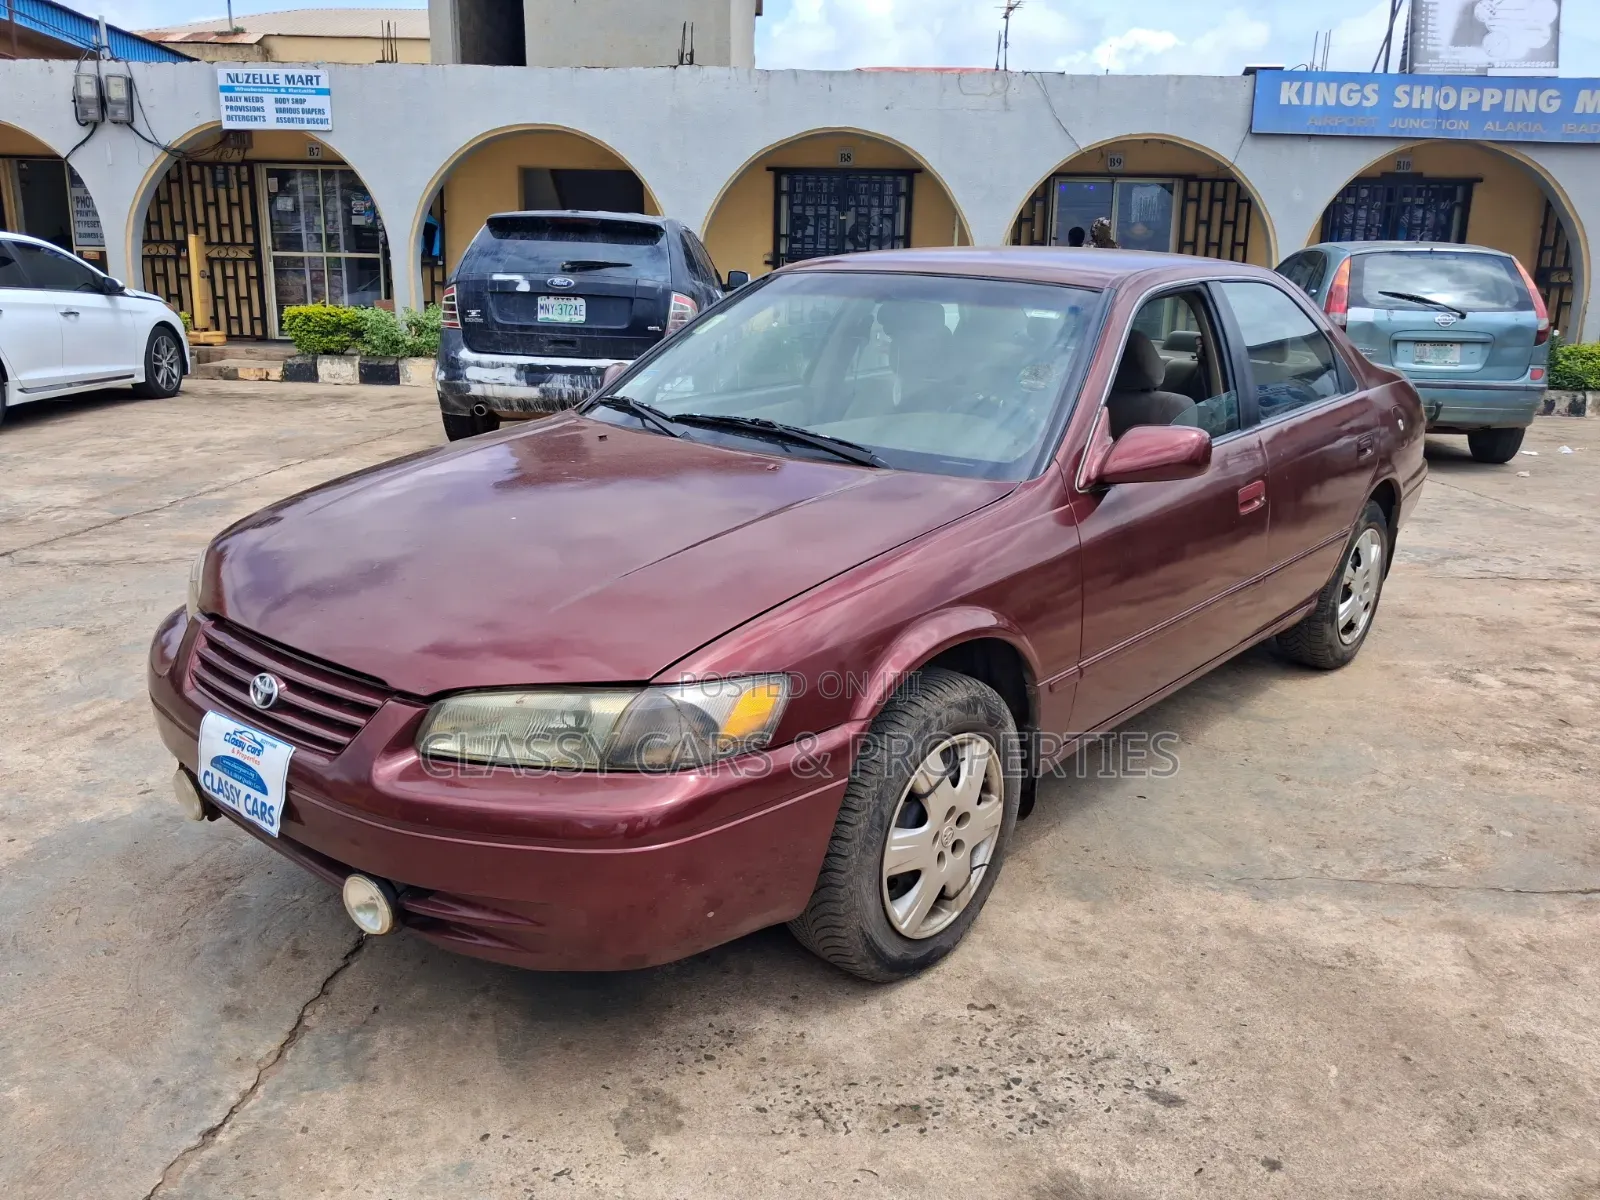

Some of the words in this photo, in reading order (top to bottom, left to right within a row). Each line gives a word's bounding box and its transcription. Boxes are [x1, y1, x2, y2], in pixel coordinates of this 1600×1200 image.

[226, 73, 280, 85] NUZELLE
[284, 74, 321, 86] MART
[224, 95, 242, 103] DAILY
[1279, 81, 1379, 107] KINGS
[1393, 84, 1561, 113] SHOPPING
[225, 105, 266, 113] PROVISIONS
[226, 114, 267, 123] DETERGENTS
[1307, 115, 1379, 128] AIRPORT
[1388, 117, 1469, 130] JUNCTION
[308, 147, 320, 157] B7
[840, 152, 852, 163] B8
[1109, 157, 1122, 168] B9
[1396, 160, 1411, 171] B10
[552, 278, 568, 286] Ford
[539, 303, 584, 317] MNY-372AE
[224, 732, 246, 751] Classy
[236, 749, 261, 766] Properties
[203, 770, 242, 808] CLASSY
[244, 793, 275, 827] CARS
